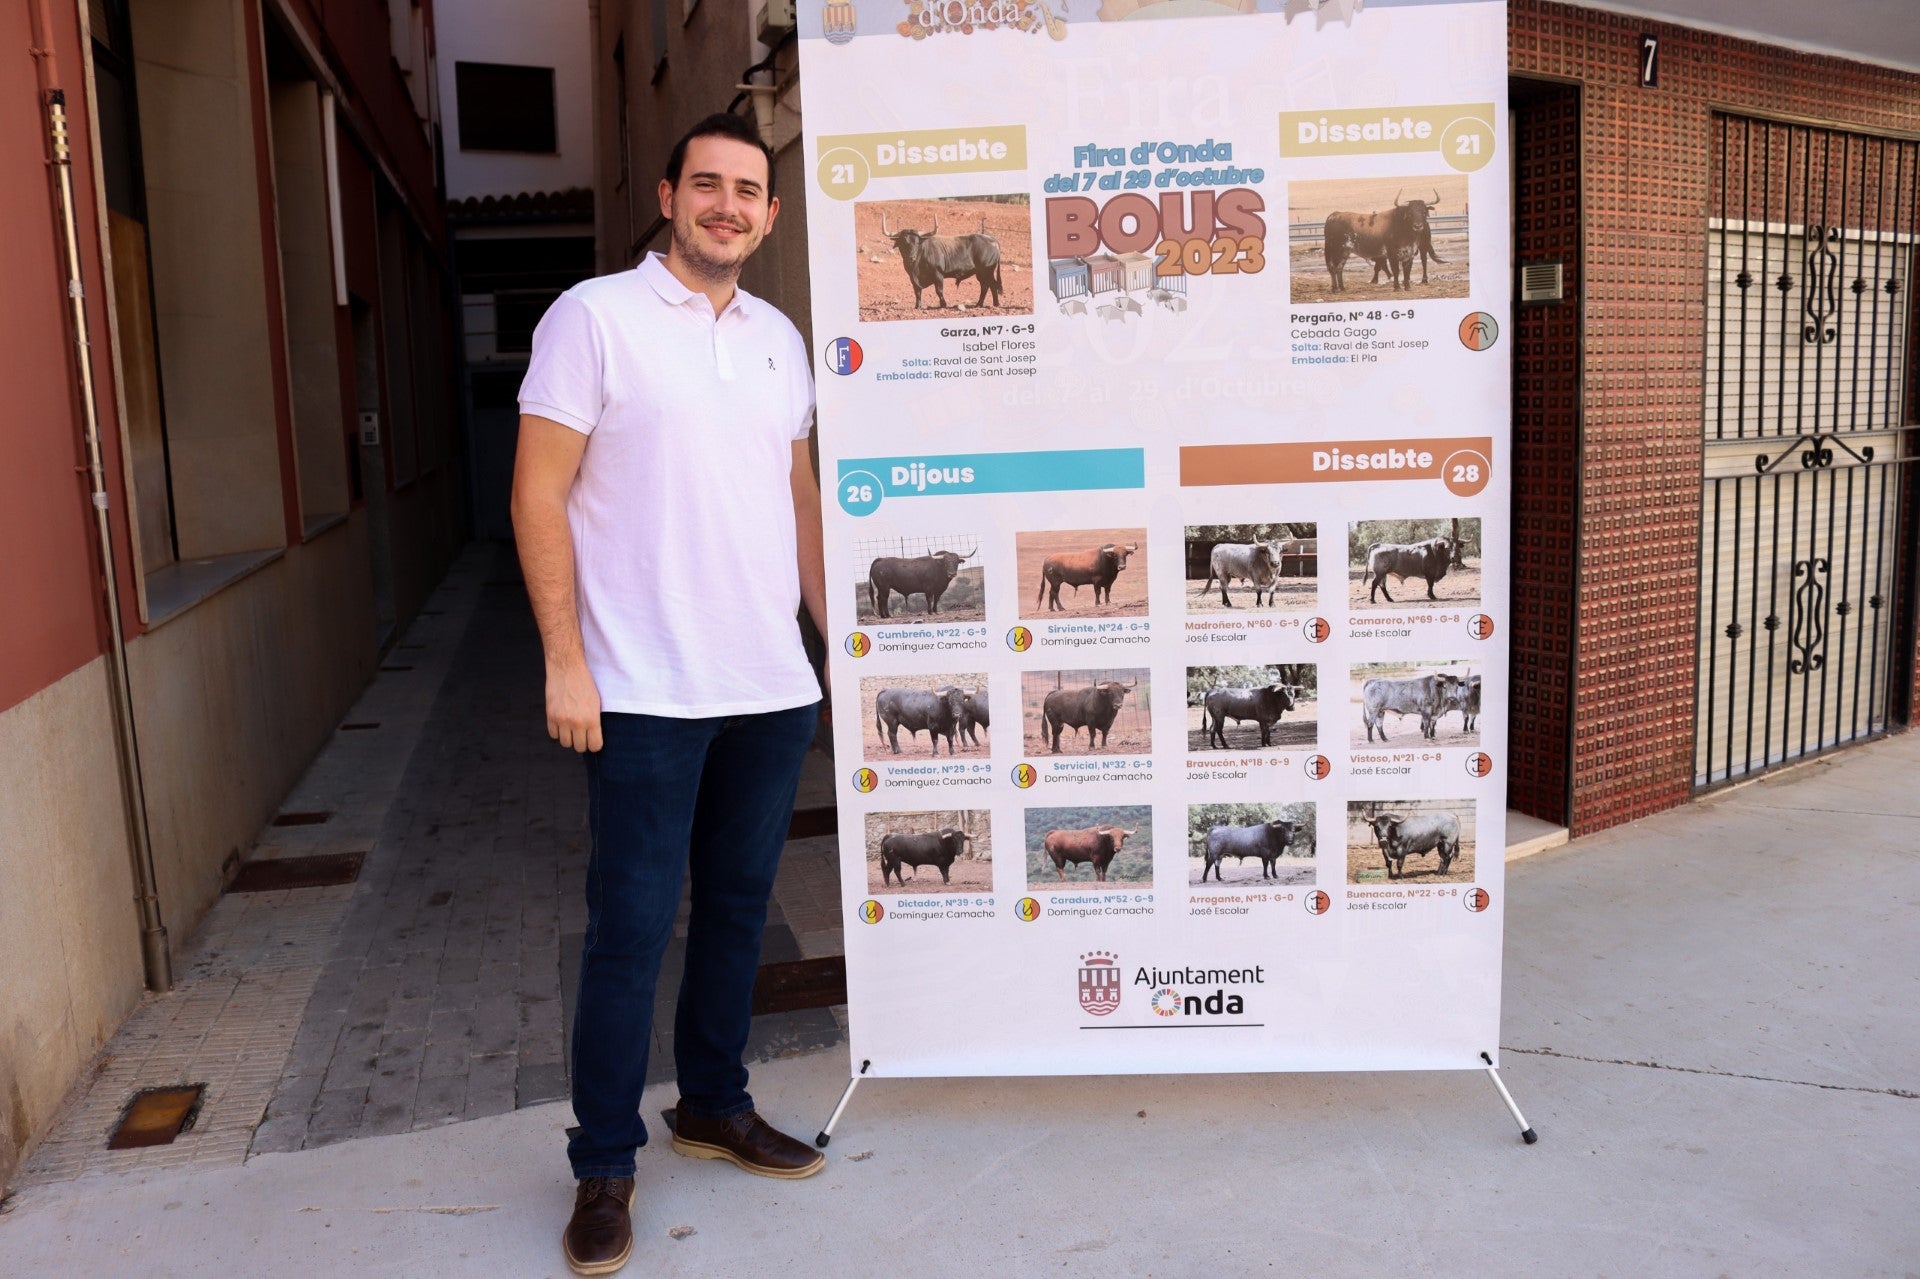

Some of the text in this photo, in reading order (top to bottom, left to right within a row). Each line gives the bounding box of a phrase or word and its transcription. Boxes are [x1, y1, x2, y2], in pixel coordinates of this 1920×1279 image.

[919, 0, 1021, 28] d'Onda
[1644, 39, 1657, 81] 7
[1298, 104, 1433, 144] Dissabte
[1456, 134, 1480, 154] 21
[877, 139, 1007, 165] Dissabte
[1074, 139, 1232, 168] Fira d'Onda
[832, 164, 854, 184] 21
[1044, 166, 1265, 193] del 7 al 29 d'octubre
[1045, 188, 1267, 259] BOUS
[1155, 235, 1265, 276] 2023
[1290, 313, 1346, 325] Pergaño,
[1367, 311, 1382, 320] 48
[941, 328, 980, 338] Garza,
[1291, 328, 1377, 339] Cebada Gago
[963, 340, 1035, 352] Isabel Flores
[1292, 340, 1429, 352] Solta: Raval de Sant Josep
[902, 354, 1036, 367] Solta: Raval de Sant Josep
[1292, 354, 1377, 365] Embolada: El Pla
[876, 367, 1036, 381] Embolada: Raval de Sant Josep
[1313, 448, 1433, 471] Dissabte
[892, 463, 974, 491] Dijous
[1453, 465, 1479, 482] 28
[847, 485, 872, 503] 26
[1185, 621, 1245, 631] Madroñero,
[1349, 617, 1405, 626] Camarero,
[877, 630, 935, 640] Cumbreño,
[1048, 624, 1097, 634] Sirviente,
[1349, 628, 1411, 638] José Escolar
[1041, 635, 1150, 648] Domínguez Camacho
[1185, 632, 1247, 643] José Escolar
[879, 639, 987, 654] Domínguez Camacho
[1186, 760, 1238, 769] Bravucón,
[1350, 754, 1390, 764] Vistoso,
[888, 766, 940, 776] Vendedor,
[1054, 761, 1100, 771] Servicial,
[1350, 765, 1411, 776] José Escolar
[1045, 772, 1152, 785] Domínguez Camacho
[1187, 770, 1247, 781] José Escolar
[885, 776, 992, 789] Domínguez Camacho
[1050, 896, 1102, 905] Caradura,
[1190, 895, 1243, 906] Arrogante,
[1347, 890, 1405, 899] Buenacara,
[898, 899, 943, 908] Dictador,
[1347, 901, 1407, 911] José Escolar
[890, 909, 995, 922] Domínguez Camacho
[1048, 906, 1154, 919] Domínguez Camacho
[1190, 906, 1249, 916] José Escolar
[1134, 965, 1264, 989] Ajuntament
